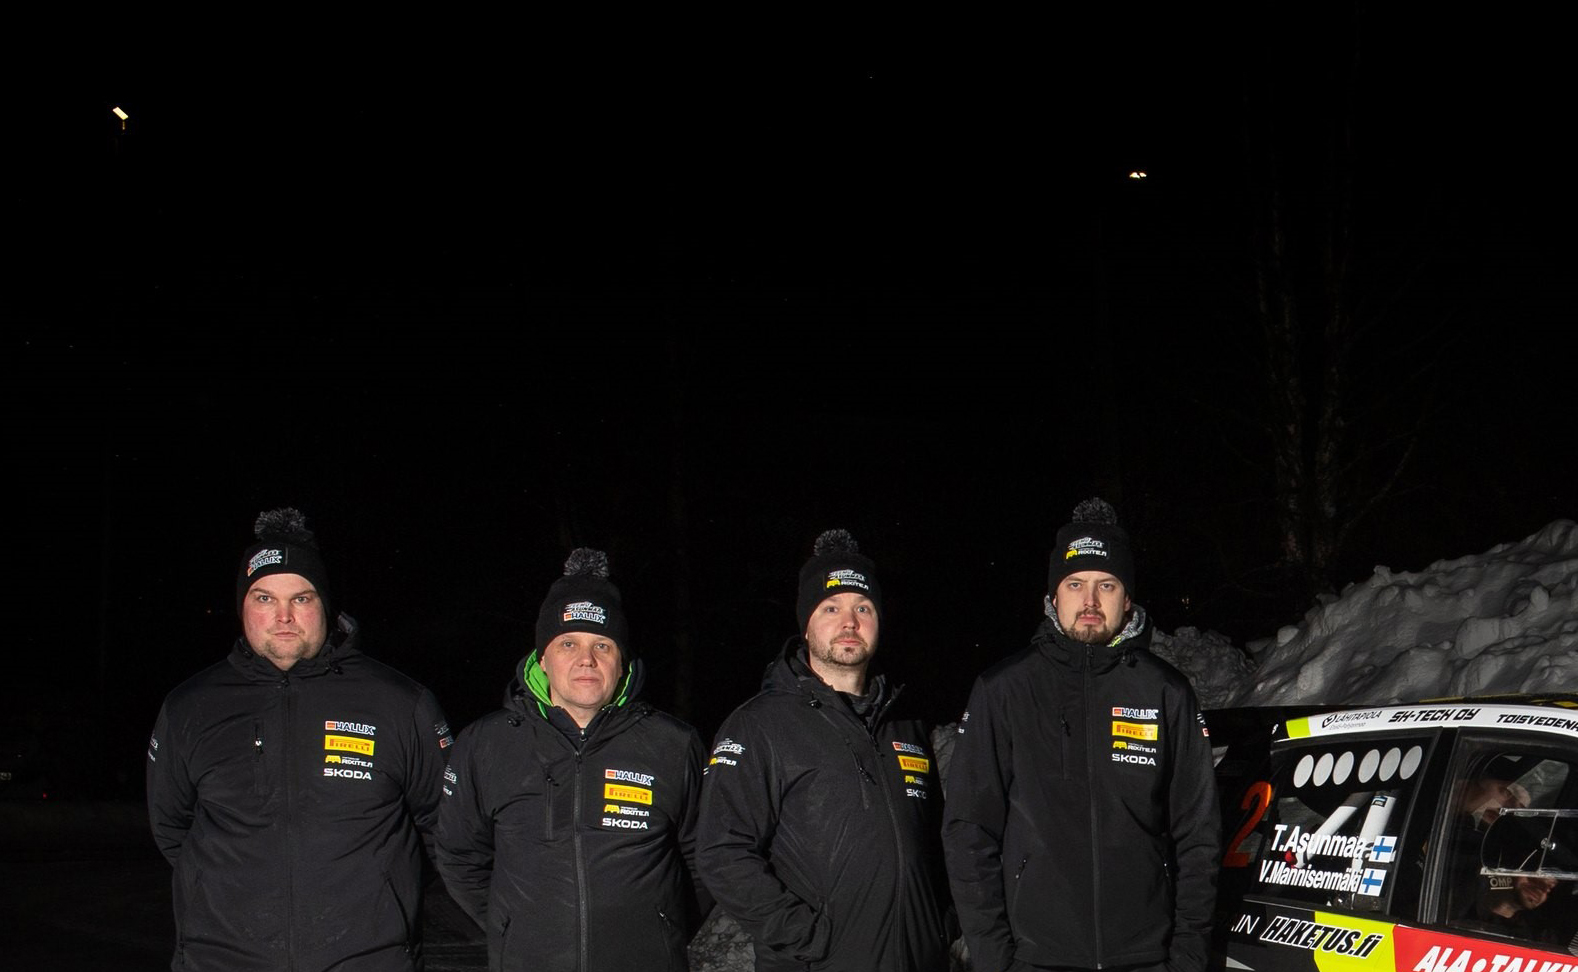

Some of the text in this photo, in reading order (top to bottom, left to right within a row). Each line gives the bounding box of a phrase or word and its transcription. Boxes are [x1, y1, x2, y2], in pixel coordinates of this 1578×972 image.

[571, 611, 606, 624] HALLIX
[1122, 708, 1159, 720] HALLIX
[1388, 708, 1482, 723] SH-TECH OY
[335, 721, 376, 735] HALLIX
[1117, 725, 1154, 738] PIRELLI
[329, 739, 370, 752] PIRELLI
[1112, 753, 1156, 766] SKODA
[323, 768, 372, 780] SKODA
[614, 770, 654, 786] HALLIX
[609, 788, 649, 801] PIRELLI
[602, 818, 648, 830] SKODA
[1222, 781, 1272, 868] 2
[1258, 859, 1364, 893] V.Mannisenmäki
[1490, 877, 1512, 887] OMP
[1260, 915, 1385, 959] HAKETUS.fi
